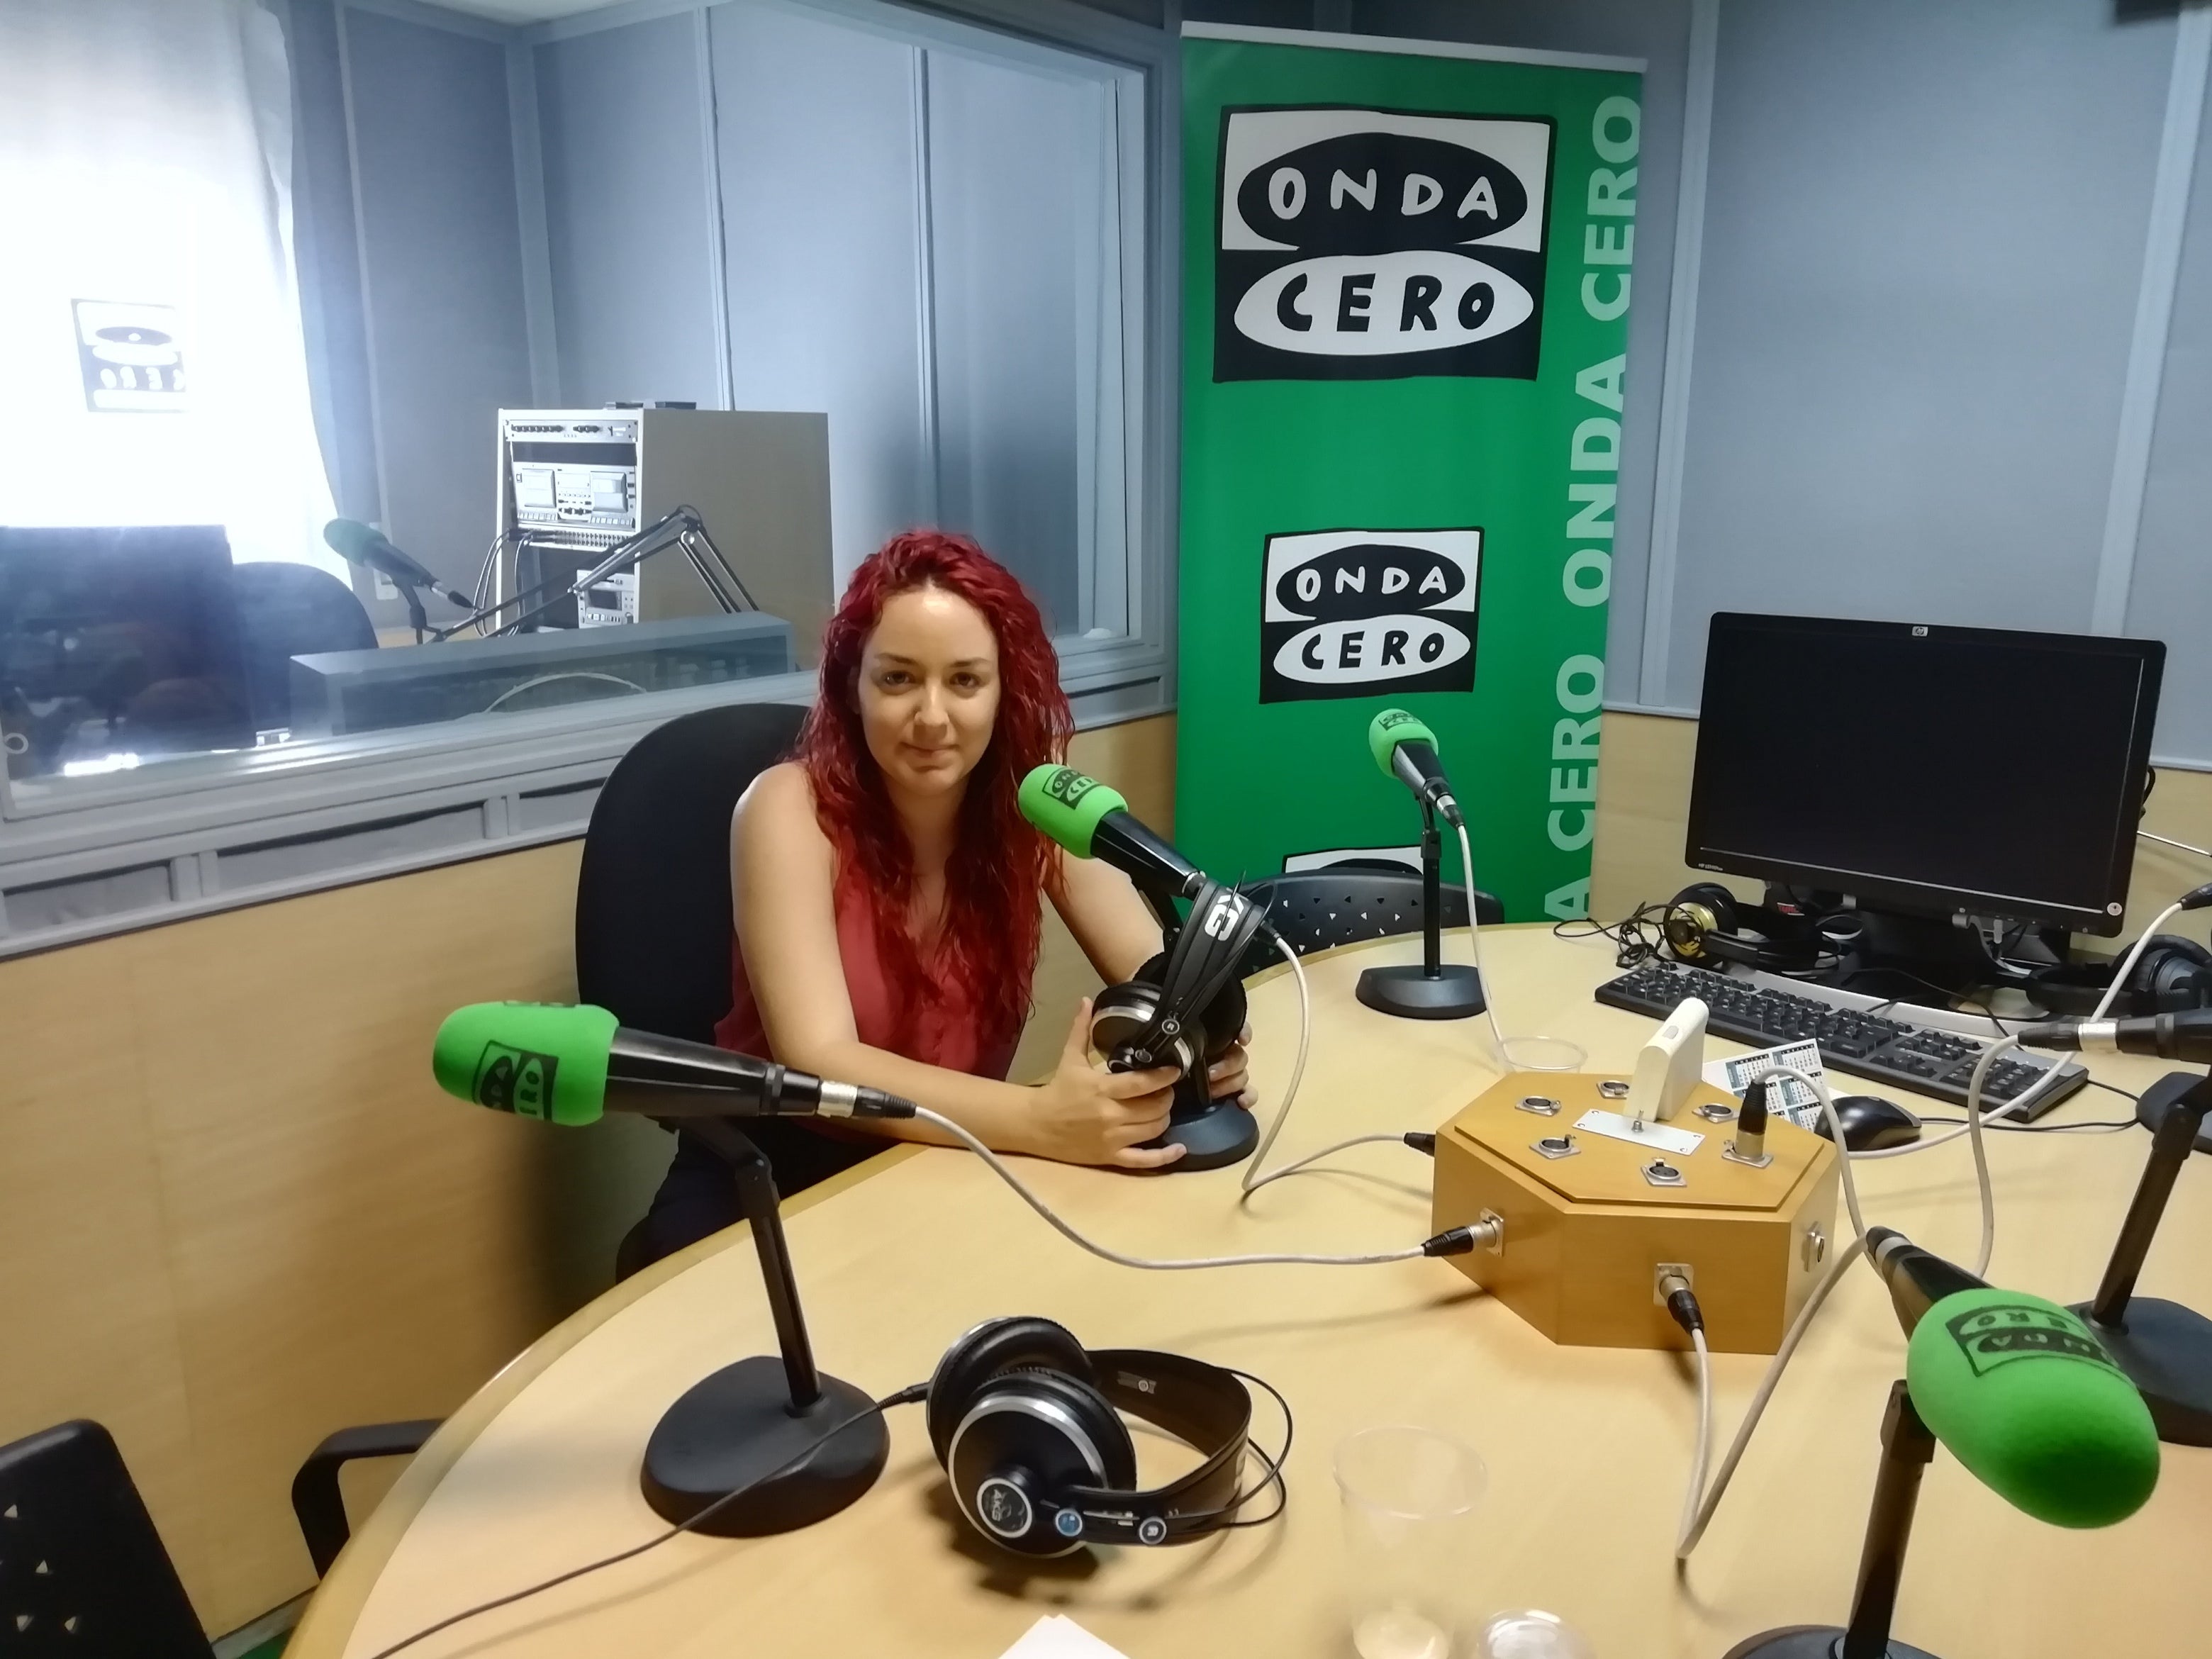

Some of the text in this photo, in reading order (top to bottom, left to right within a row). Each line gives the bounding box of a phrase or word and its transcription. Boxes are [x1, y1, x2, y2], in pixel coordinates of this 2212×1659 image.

[1268, 167, 1498, 220] ONDA
[1580, 96, 1641, 321] CERO
[1276, 272, 1495, 332] CERO
[1562, 354, 1626, 607] ONDA
[1296, 566, 1447, 602] ONDA
[1301, 630, 1445, 670] CERO
[1547, 654, 1606, 851] CERO
